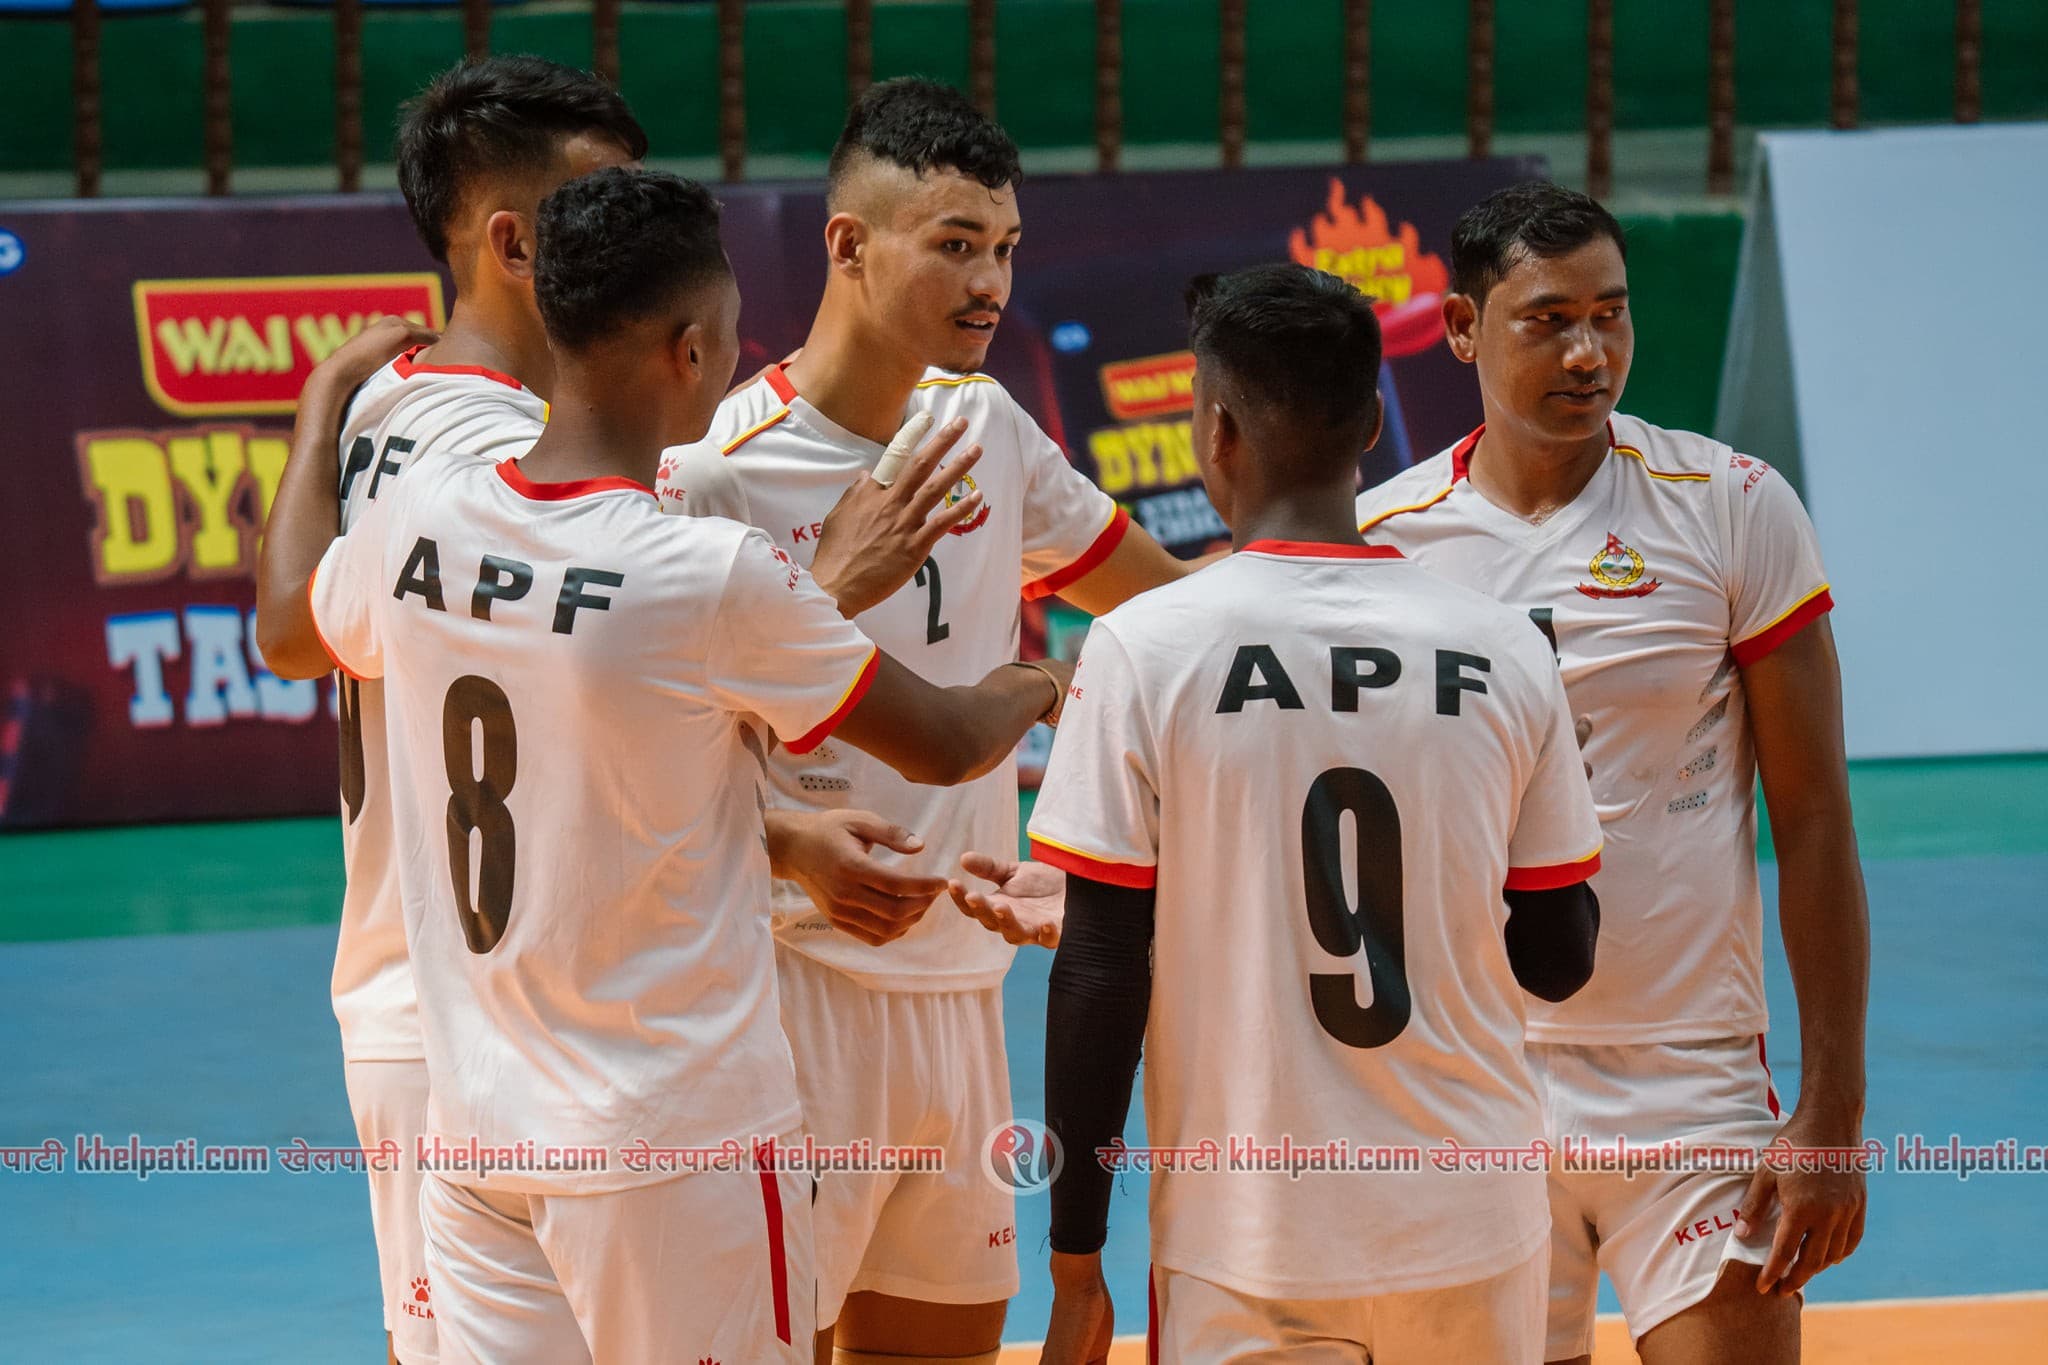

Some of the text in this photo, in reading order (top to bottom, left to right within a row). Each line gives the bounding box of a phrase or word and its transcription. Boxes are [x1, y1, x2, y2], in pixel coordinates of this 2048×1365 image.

[157, 315, 294, 376] WAI
[914, 554, 950, 646] 2
[442, 673, 519, 956] 8
[1301, 766, 1413, 1050] 9
